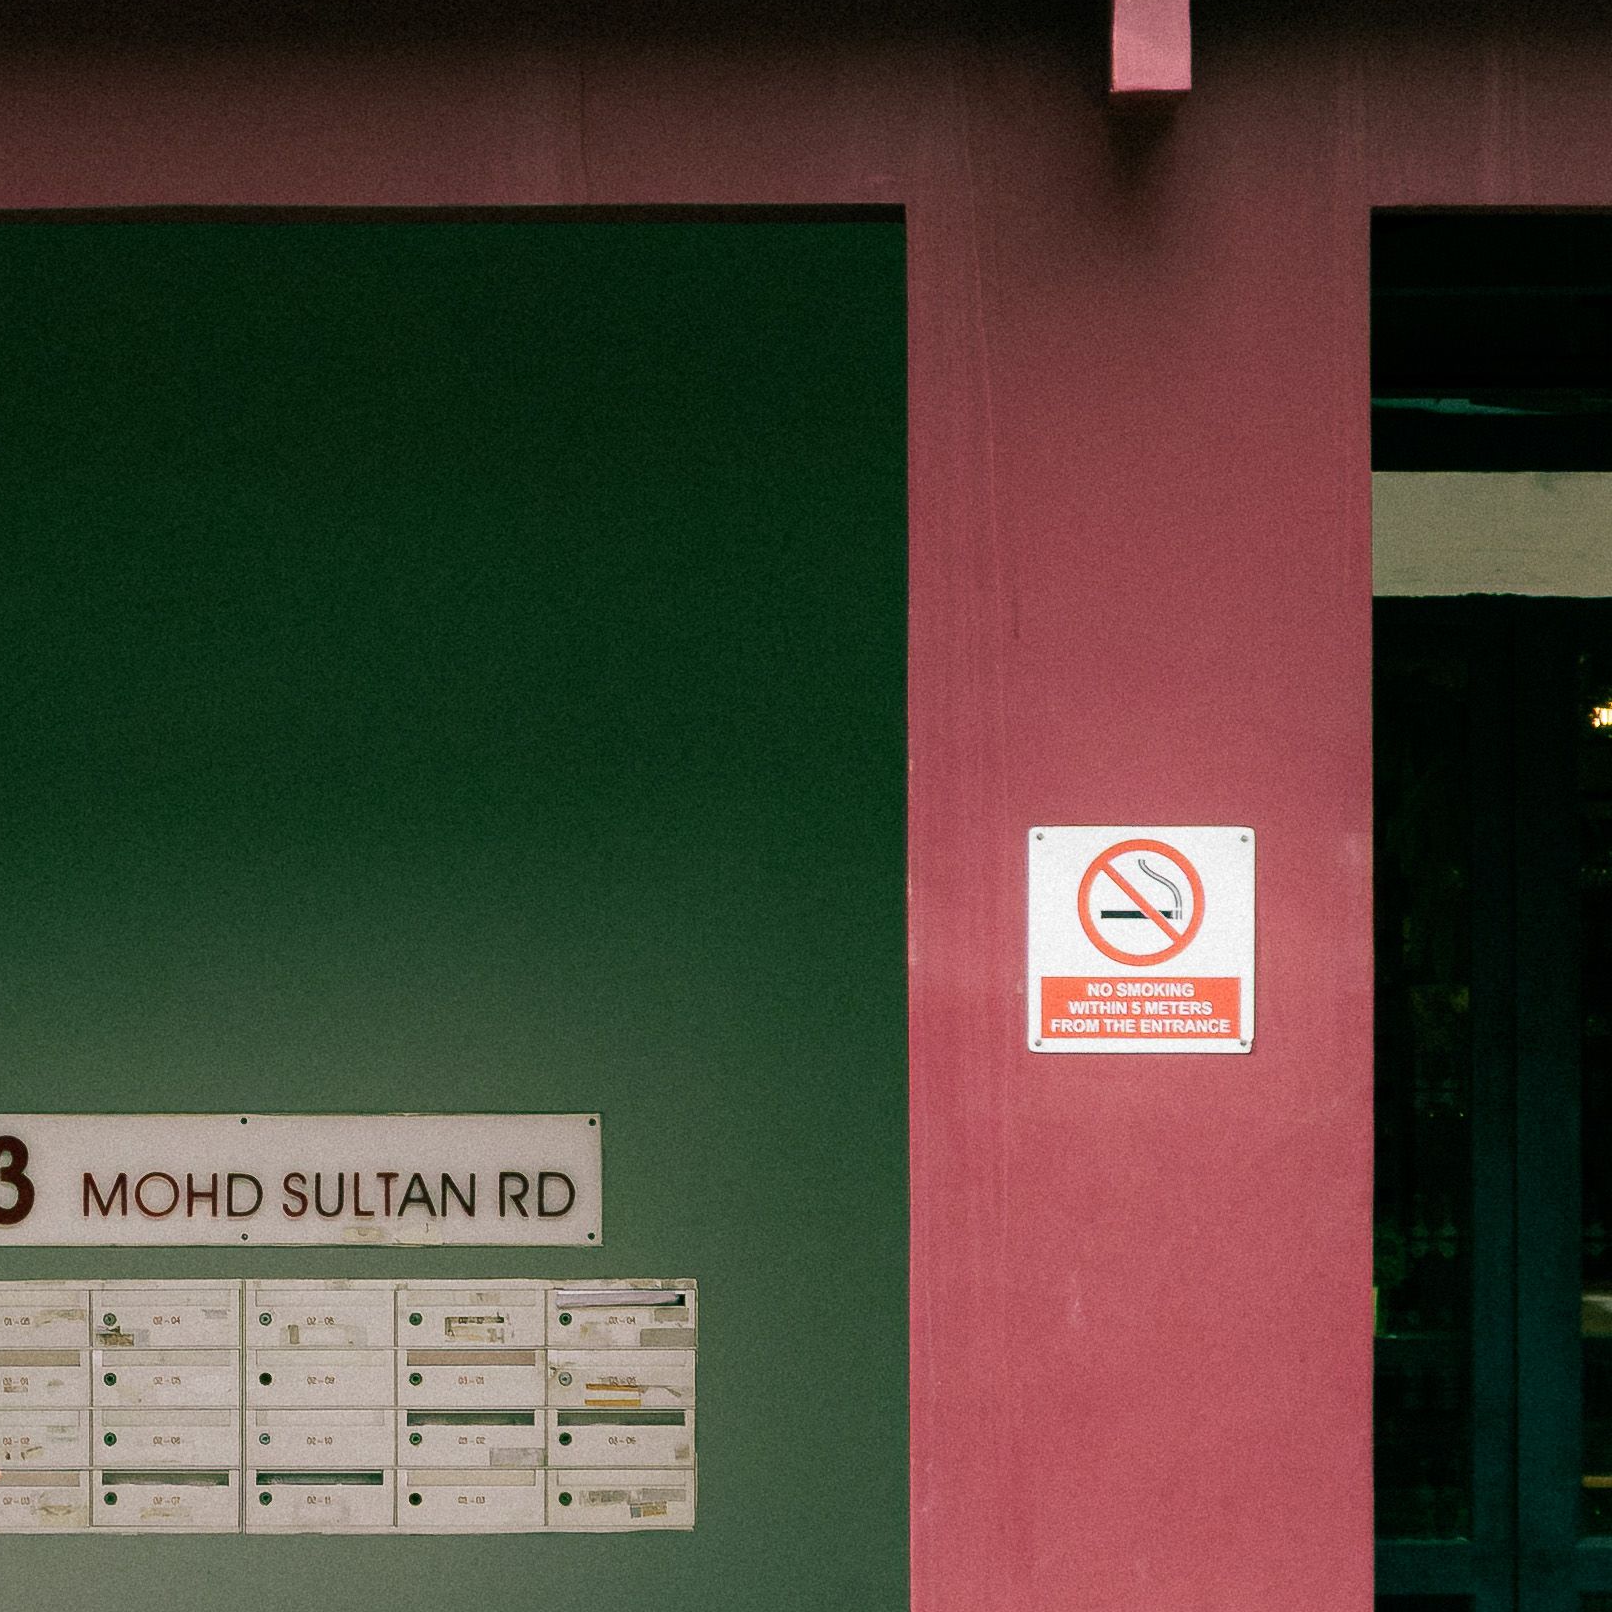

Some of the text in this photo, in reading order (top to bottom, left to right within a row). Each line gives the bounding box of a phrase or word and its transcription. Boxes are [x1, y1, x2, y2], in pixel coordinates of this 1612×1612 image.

[1088, 983, 1194, 997] NO SMOKING
[1068, 1001, 1213, 1015] WITHIN 5 METERS
[1051, 1019, 1231, 1033] FROM THE ENTRANCE
[82, 1171, 263, 1217] MOHD
[281, 1171, 475, 1217] SULTAN
[498, 1171, 576, 1217] RD
